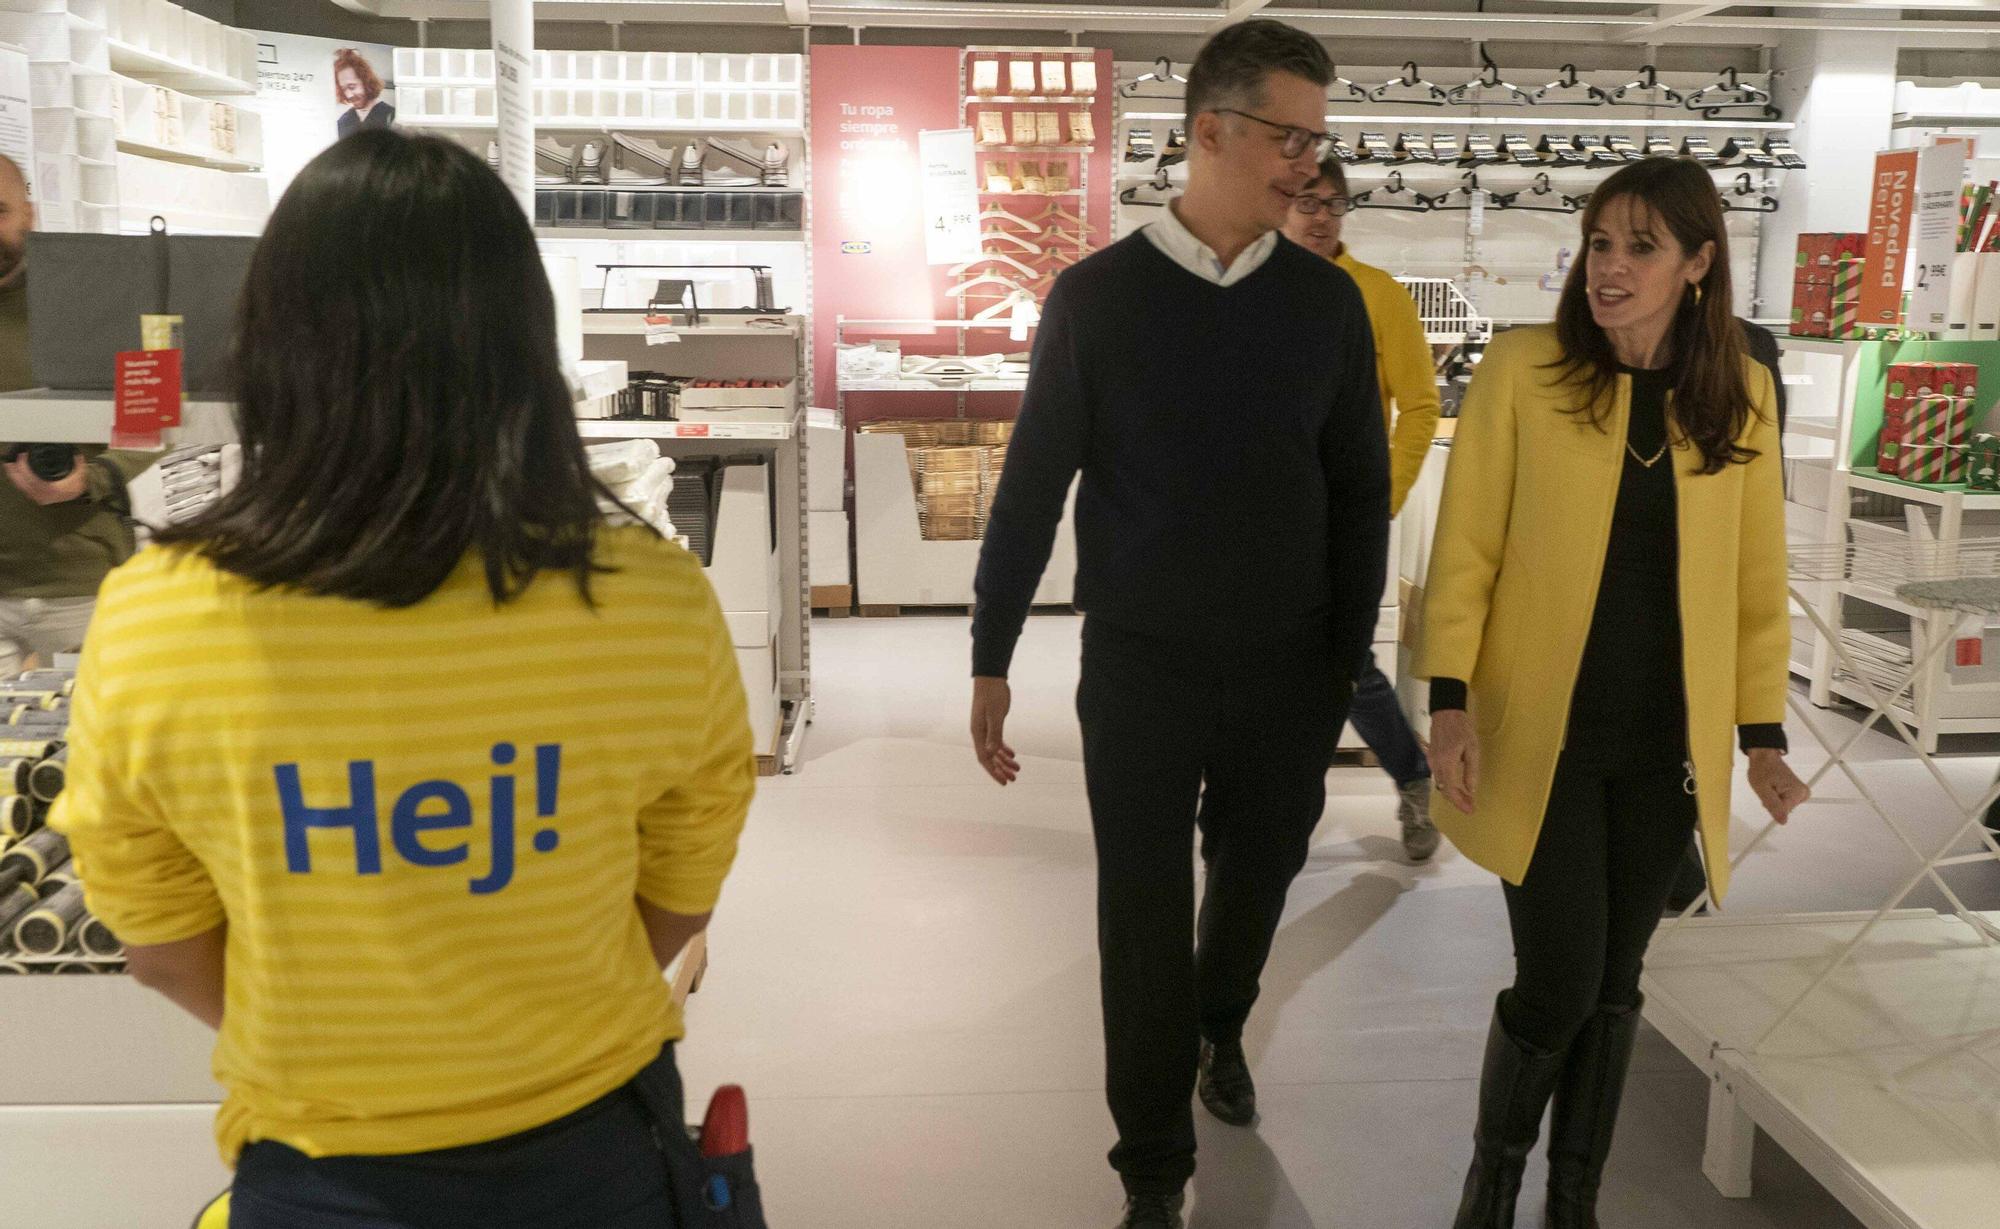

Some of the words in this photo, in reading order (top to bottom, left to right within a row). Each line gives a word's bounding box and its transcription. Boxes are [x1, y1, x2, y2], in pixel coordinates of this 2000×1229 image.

[839, 103, 857, 116] Tu
[861, 105, 895, 119] ropa
[839, 120, 898, 135] siempre
[1881, 170, 1908, 287] Novedad
[273, 742, 562, 895] Hej!
